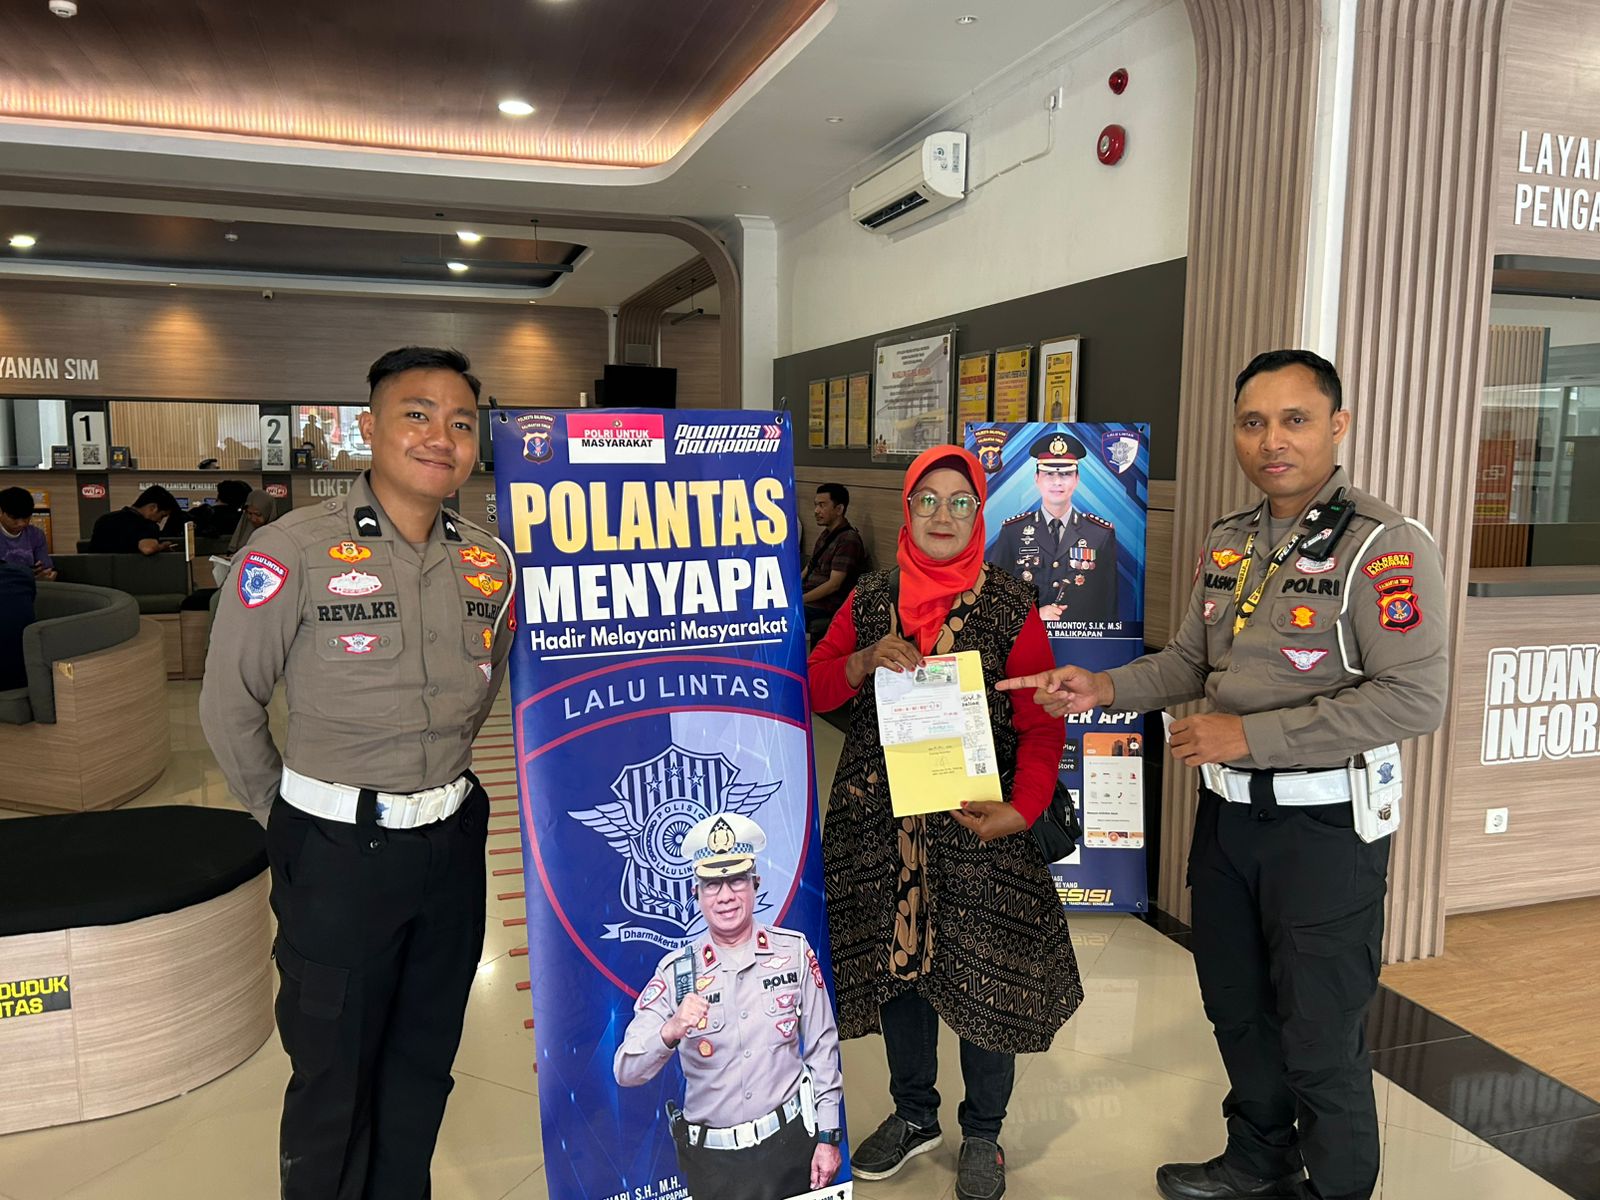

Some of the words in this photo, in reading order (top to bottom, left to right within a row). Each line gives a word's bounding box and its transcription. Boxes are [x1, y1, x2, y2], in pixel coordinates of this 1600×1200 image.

[1514, 184, 1600, 232] PENGA
[64, 359, 99, 380] SIM
[79, 415, 91, 441] 1
[267, 418, 281, 444] 2
[584, 429, 613, 438] POLRI
[615, 429, 649, 438] UNTUK
[674, 424, 760, 440] POLANTAS
[581, 439, 653, 447] MASYARAKAT
[675, 439, 781, 455] BALIKPAPAN
[310, 479, 353, 497] LOKET
[509, 477, 789, 554] POLANTAS
[250, 555, 265, 565] LALU
[264, 560, 284, 575] LINTAS
[521, 556, 789, 625] MENYAPA
[1282, 577, 1340, 596] POLRI
[317, 601, 398, 623] REVA.KR
[530, 626, 586, 651] Hadir
[590, 622, 676, 649] Melayani
[680, 615, 789, 643] Masyarakat
[1046, 621, 1088, 631] KUMONTOY,
[1107, 621, 1122, 630] M.Si
[1054, 630, 1103, 638] BALIKPAPAN
[564, 679, 646, 720] LALU
[658, 674, 769, 699] LINTAS
[1064, 709, 1094, 724] ER
[1097, 711, 1139, 725] APP
[1483, 702, 1600, 762] INFOR
[656, 803, 698, 819] POLISI
[656, 862, 677, 875] LALU
[678, 866, 693, 875] LIN
[1056, 888, 1112, 903] ESISI
[624, 930, 678, 949] Dharmakerta
[0, 975, 68, 1000] DUDUK
[763, 972, 798, 989] POLRI
[634, 1184, 658, 1200] S.H.,
[659, 1176, 682, 1194] M.H.
